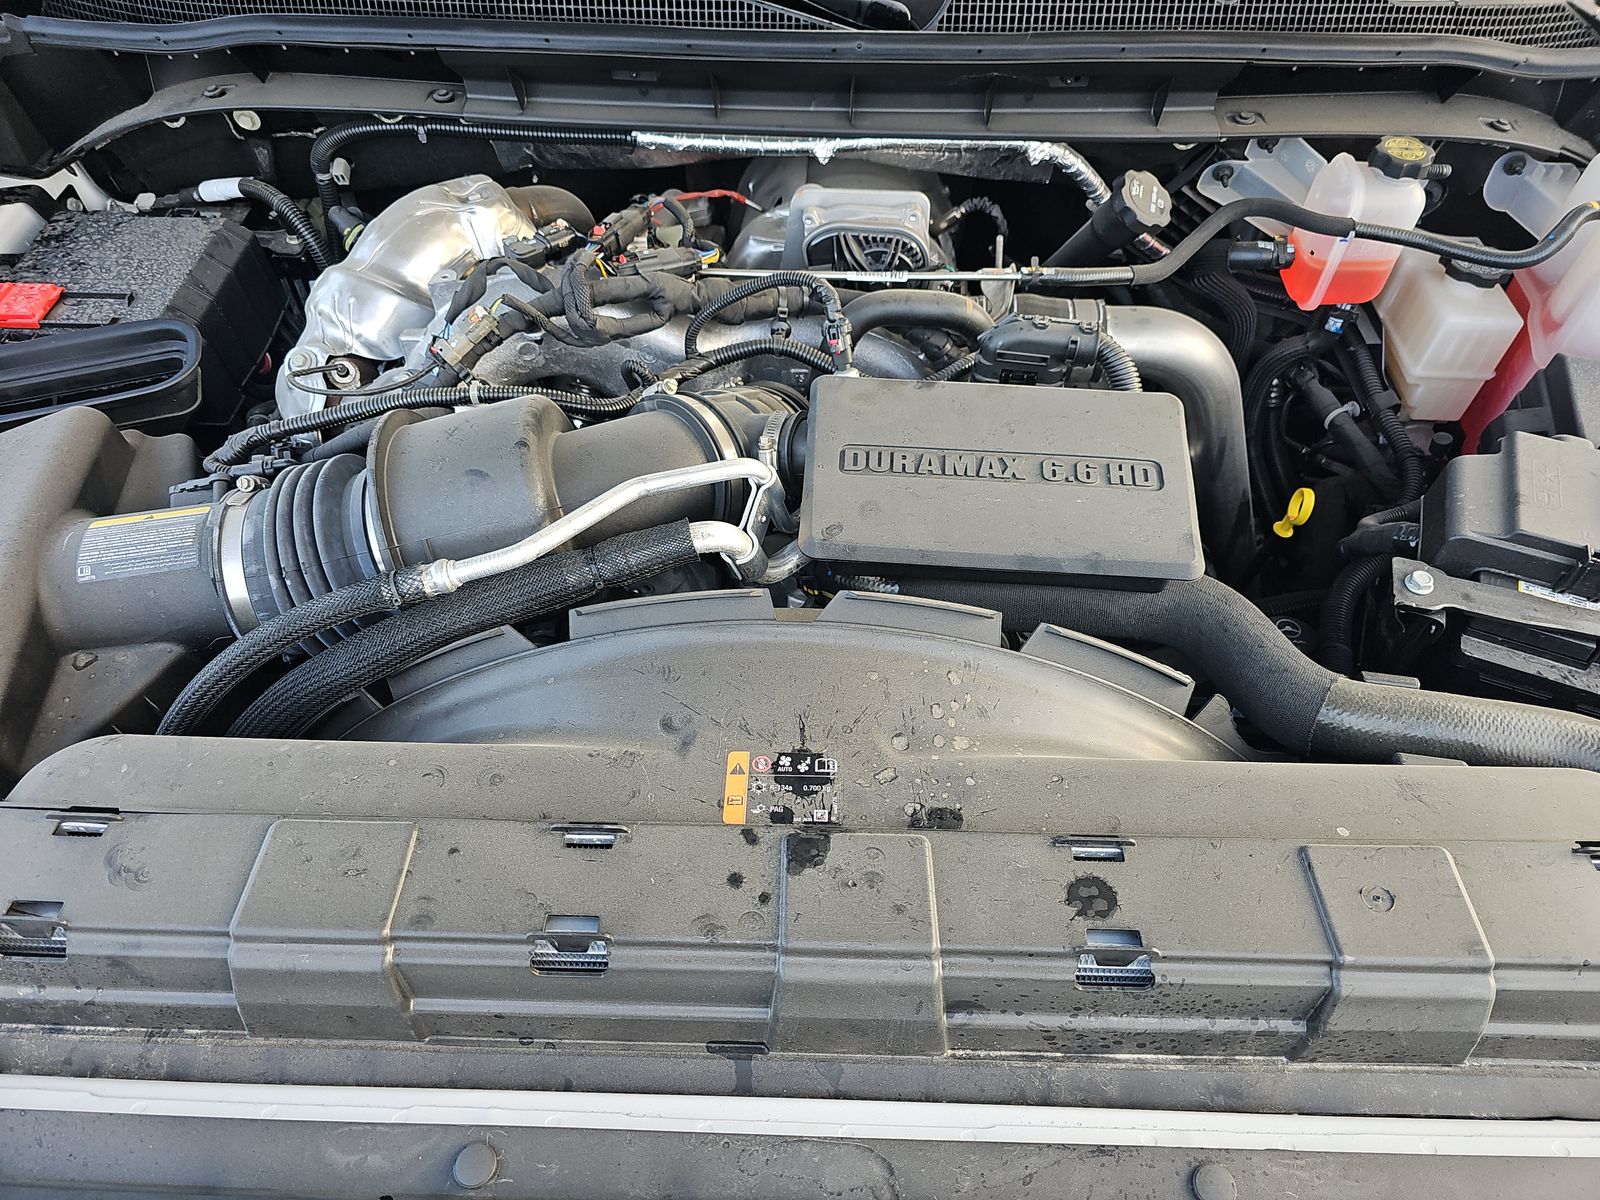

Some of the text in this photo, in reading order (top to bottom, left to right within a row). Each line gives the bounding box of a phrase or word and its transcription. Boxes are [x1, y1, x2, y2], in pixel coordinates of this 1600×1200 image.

[843, 448, 1159, 488] DURAMAX 6.6 HD
[769, 805, 784, 813] PAG
